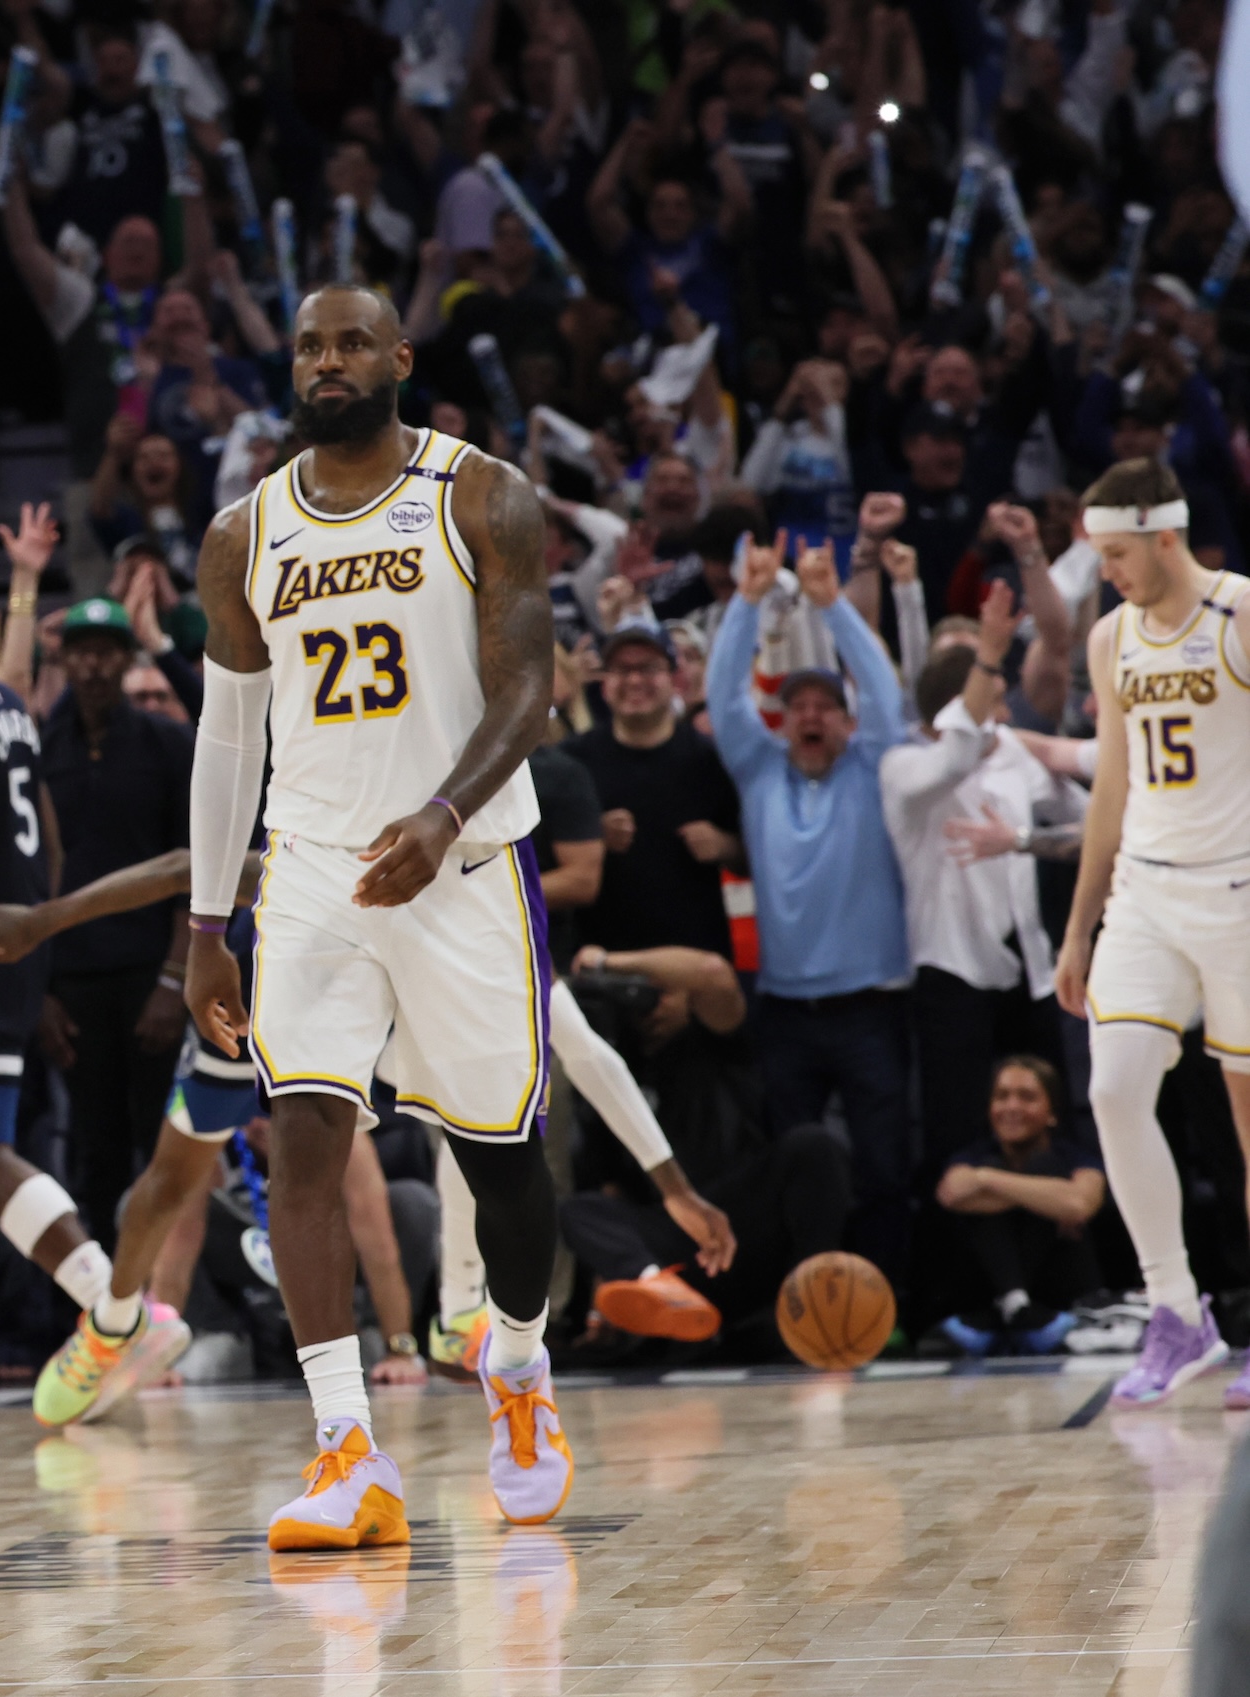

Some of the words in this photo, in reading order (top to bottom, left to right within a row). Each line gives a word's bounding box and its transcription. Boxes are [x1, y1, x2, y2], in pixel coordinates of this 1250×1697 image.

[391, 509, 431, 523] bibigo
[268, 547, 426, 623] LAKERS
[300, 620, 411, 727] 23
[1118, 667, 1218, 713] LAKERS
[1140, 714, 1198, 791] 15
[8, 766, 40, 858] 5
